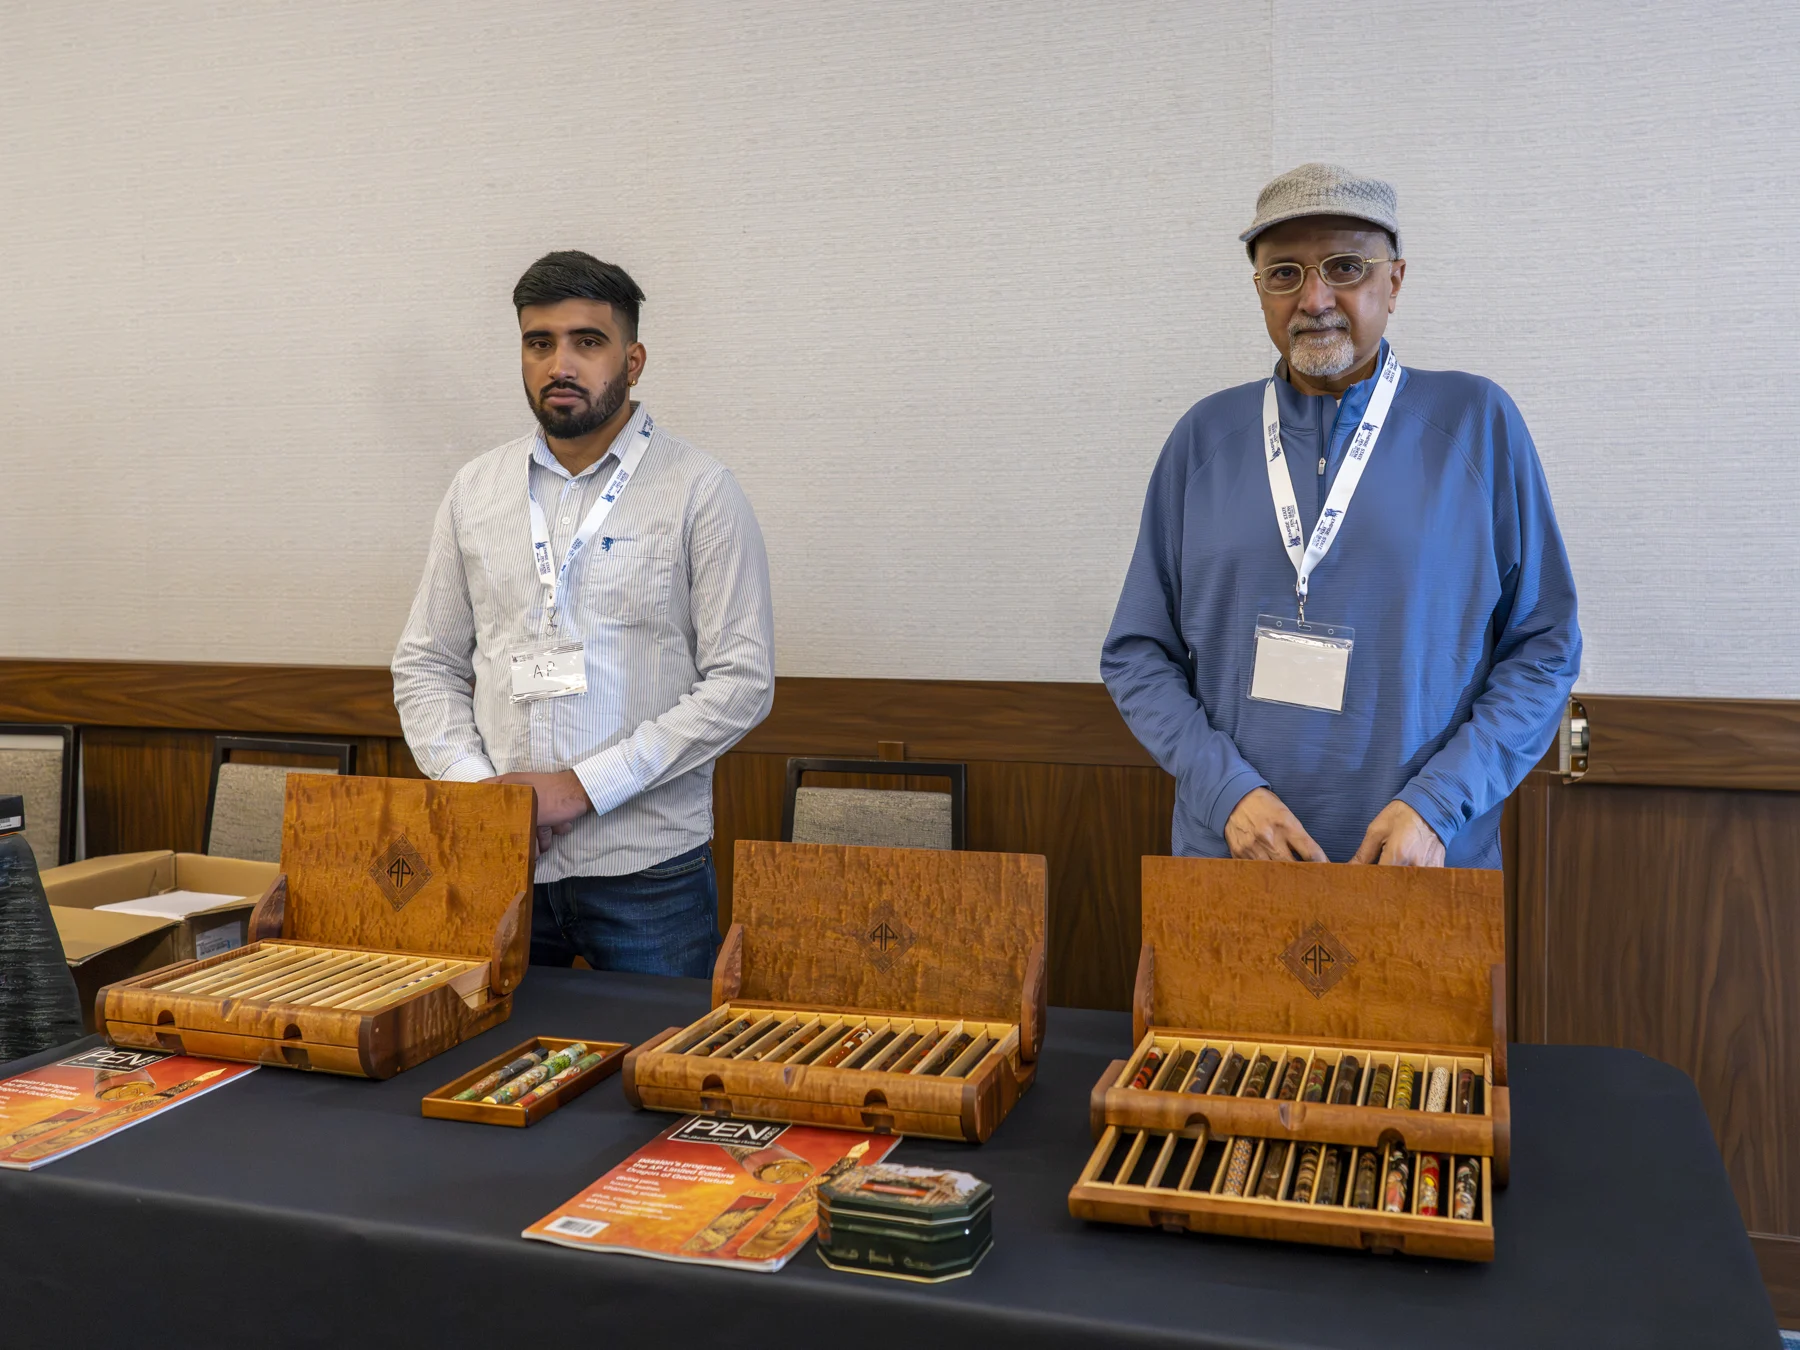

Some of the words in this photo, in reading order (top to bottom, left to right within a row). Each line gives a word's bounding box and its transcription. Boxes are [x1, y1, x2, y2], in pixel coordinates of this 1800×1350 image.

[79, 1049, 154, 1066] PEN
[683, 1119, 771, 1140] PEN
[637, 1157, 682, 1169] passion's
[626, 1167, 660, 1177] Dragon
[672, 1173, 698, 1182] Good
[697, 1176, 735, 1186] Fortune
[663, 1166, 697, 1176] Limited
[697, 1170, 735, 1180] Editions
